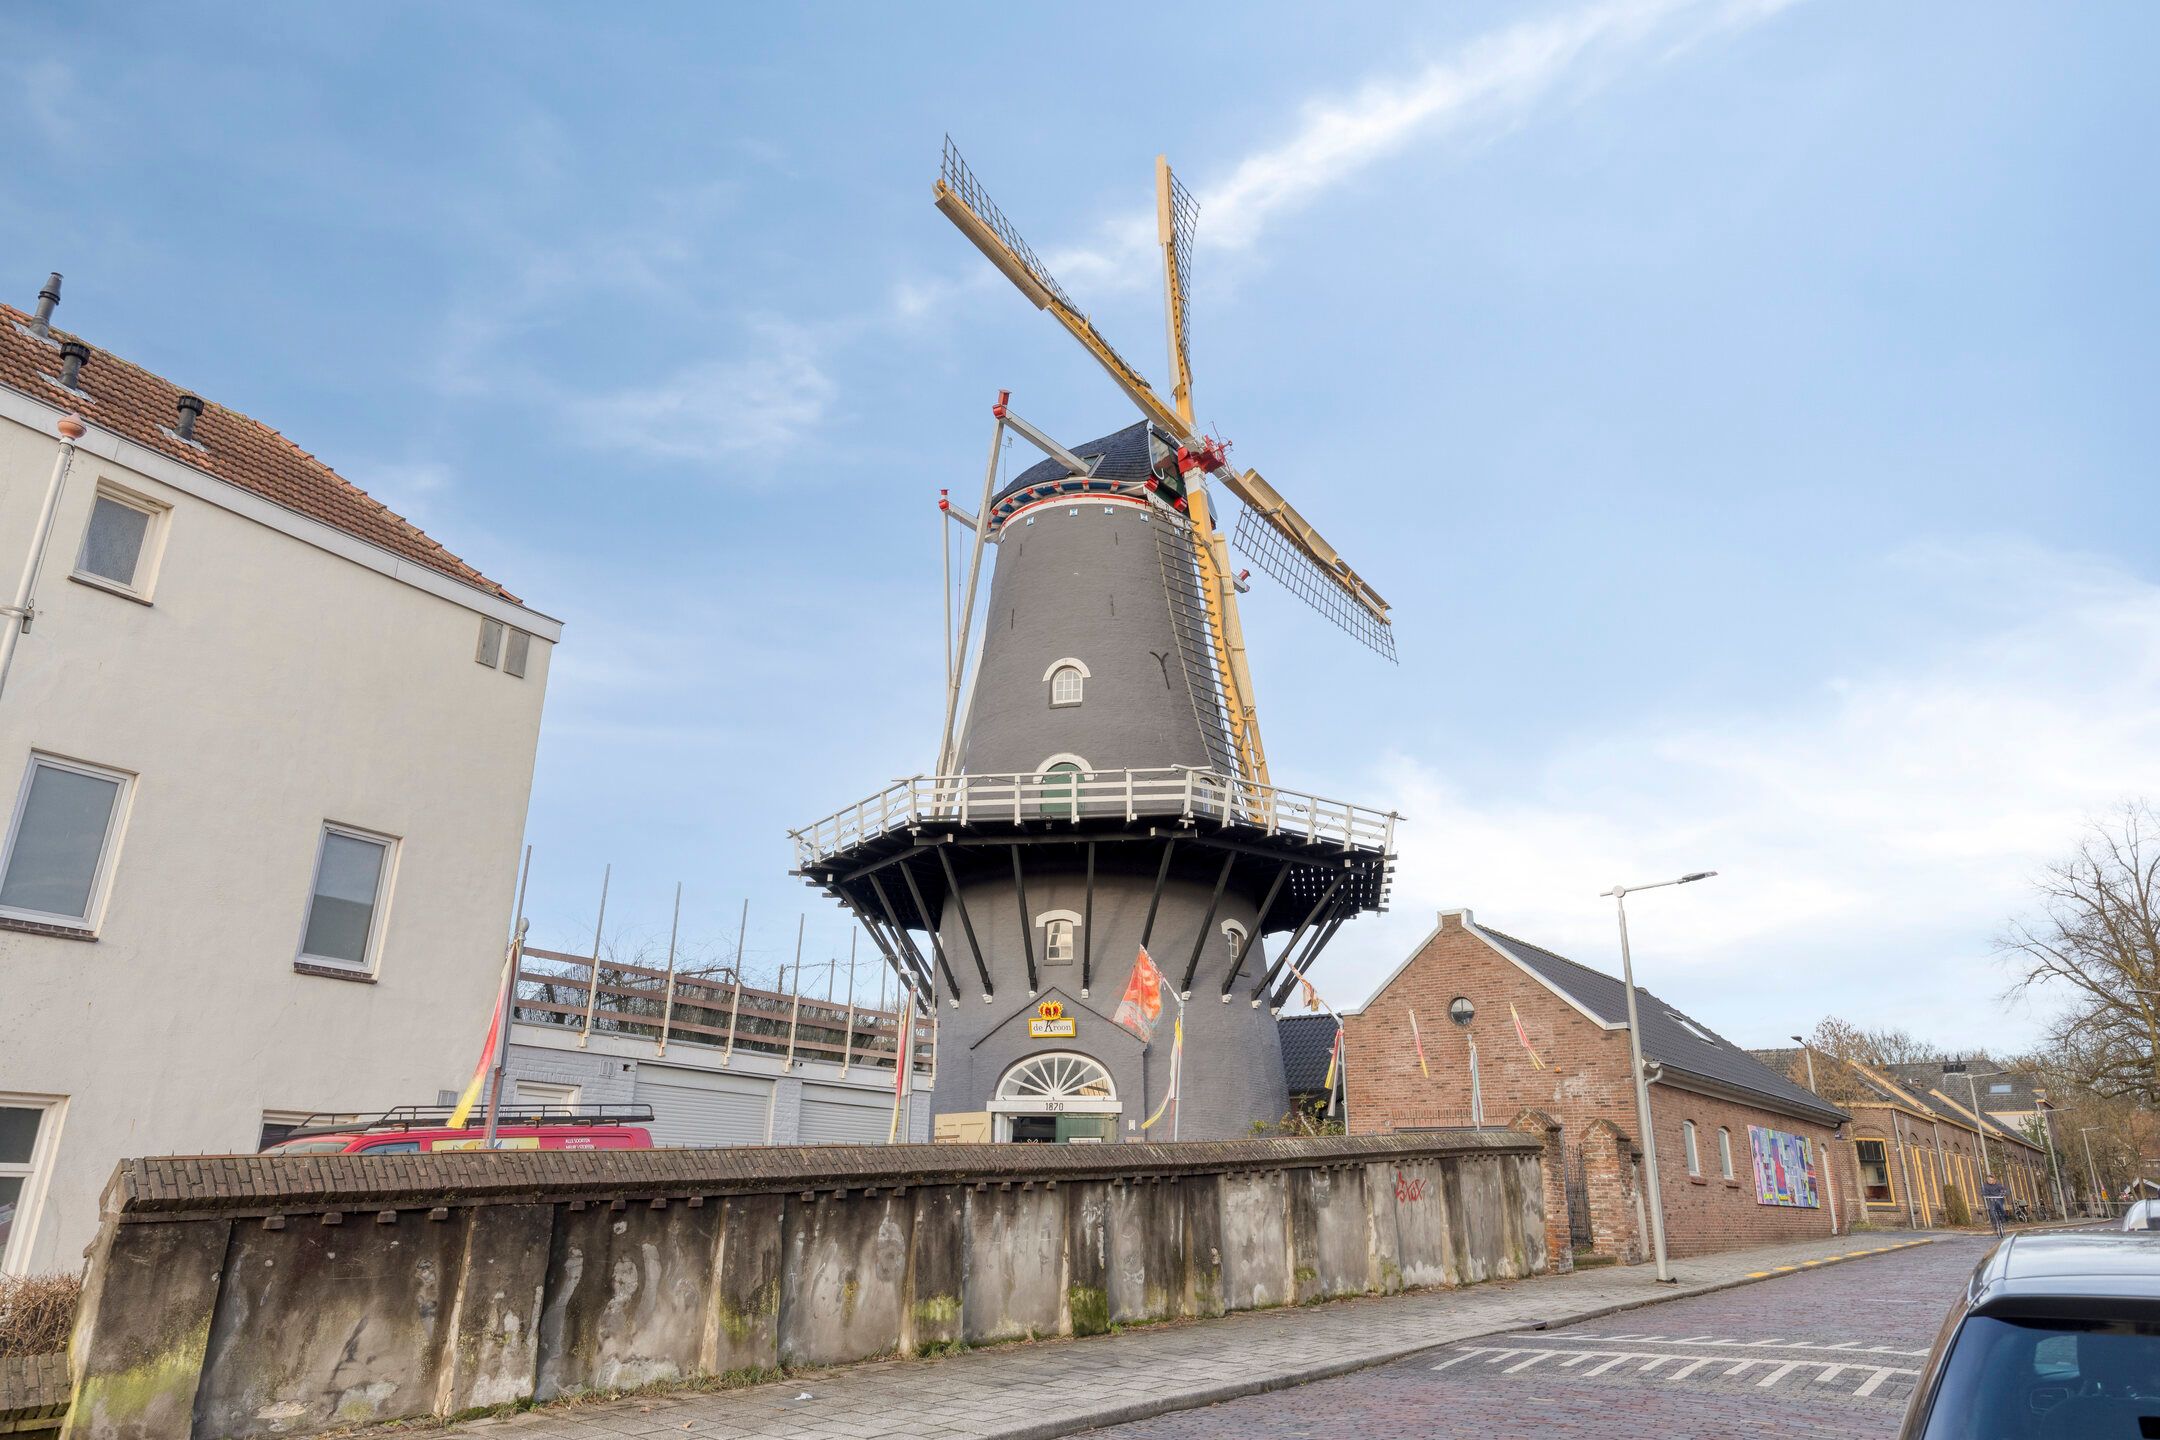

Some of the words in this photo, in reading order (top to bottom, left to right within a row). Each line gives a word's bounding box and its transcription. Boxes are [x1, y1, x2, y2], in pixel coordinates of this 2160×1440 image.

[1033, 1023, 1043, 1031] de
[1044, 1020, 1072, 1032] Kroon
[1045, 1102, 1064, 1111] 1870
